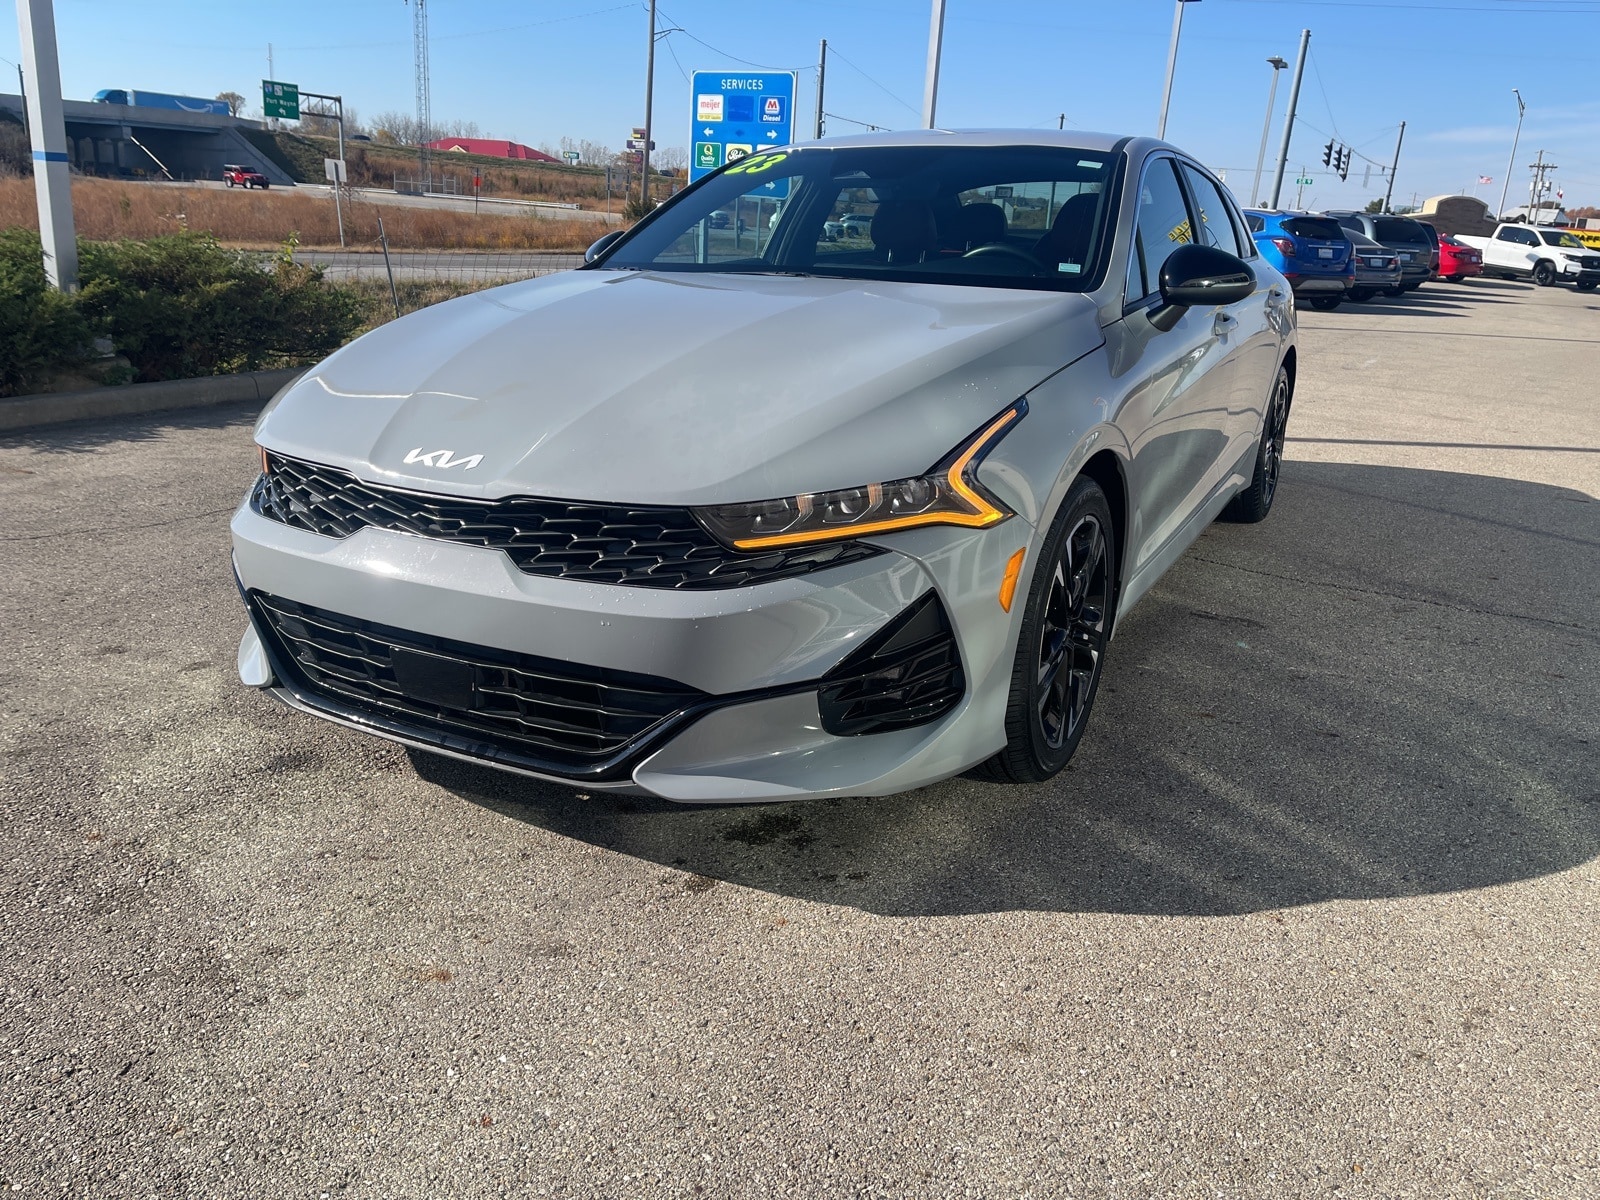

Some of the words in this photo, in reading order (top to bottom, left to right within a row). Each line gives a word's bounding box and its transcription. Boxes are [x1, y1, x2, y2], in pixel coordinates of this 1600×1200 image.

[721, 79, 763, 90] SERVICES
[279, 99, 296, 107] Wayne
[700, 99, 720, 110] meijer
[767, 100, 777, 108] M
[724, 154, 787, 174] 23
